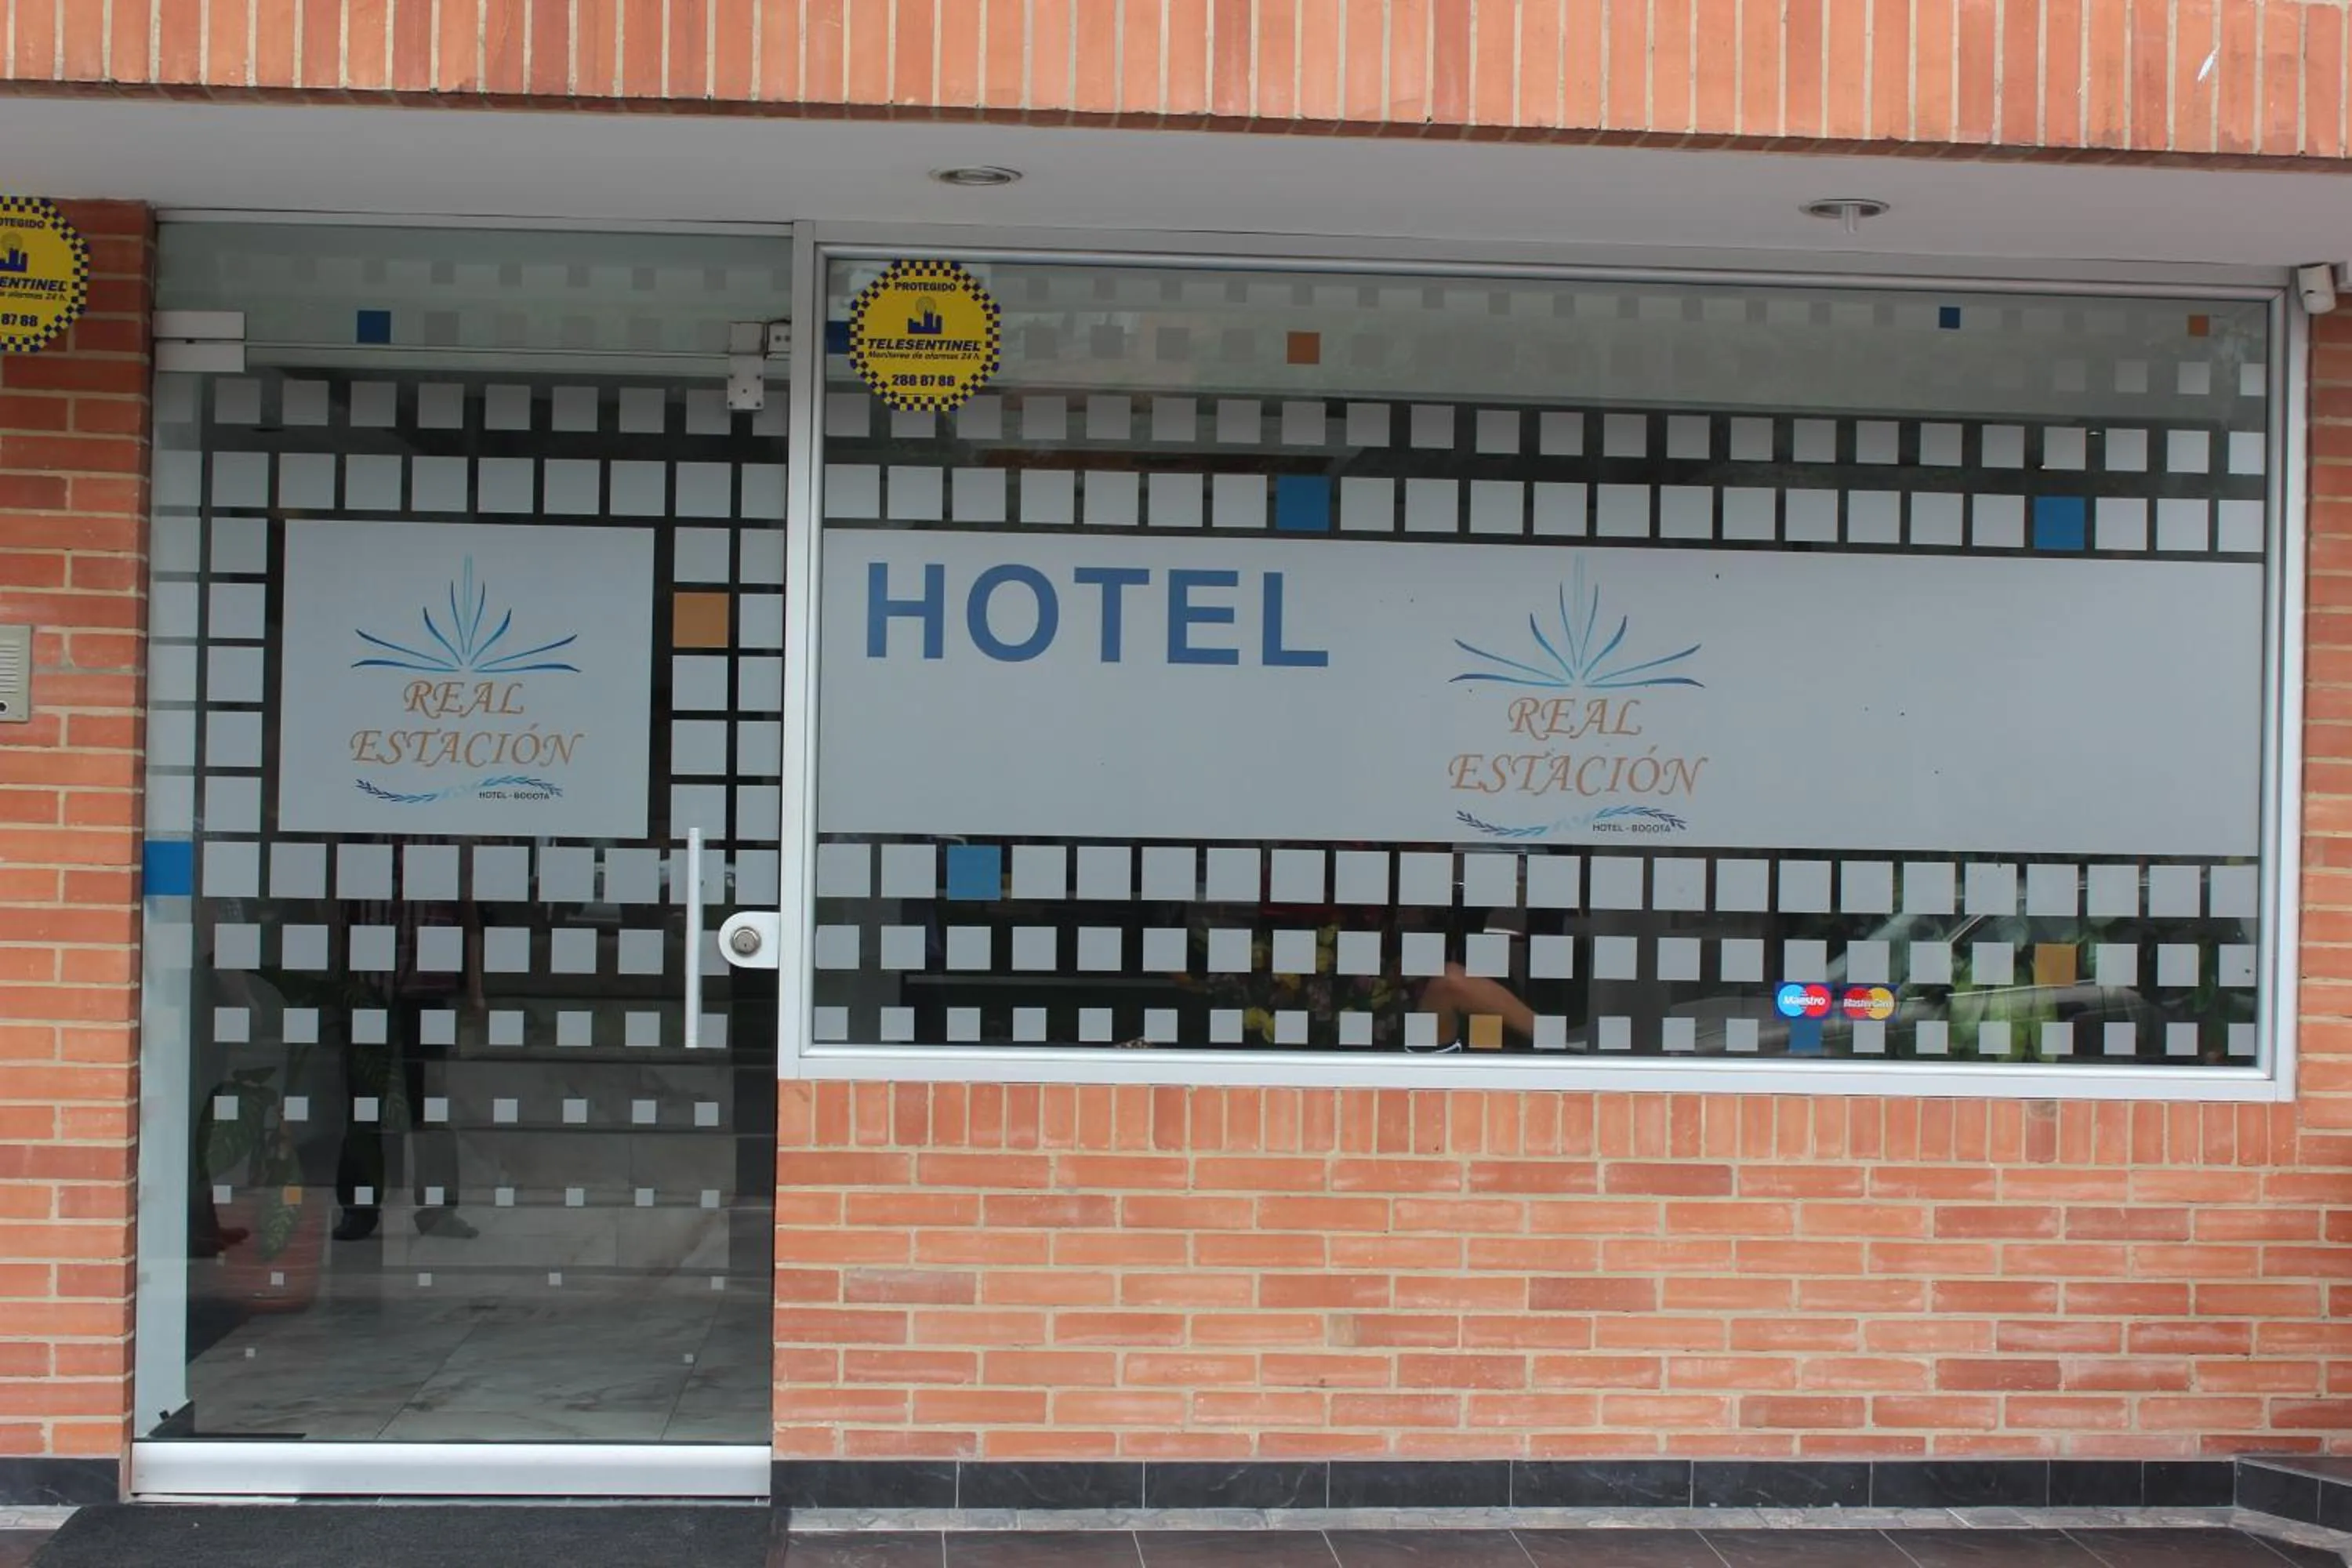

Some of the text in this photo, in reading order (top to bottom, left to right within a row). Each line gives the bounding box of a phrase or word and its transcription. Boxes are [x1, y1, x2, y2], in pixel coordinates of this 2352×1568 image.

[894, 281, 957, 292] PROTEGIDO
[867, 339, 981, 351] TELESENTINEL
[867, 562, 1329, 667] HOTEL
[403, 680, 524, 720] REAL
[1508, 697, 1642, 741] REAL
[350, 723, 585, 768] ESTACIÓN
[1448, 746, 1709, 797] ESTACIÓN
[1592, 823, 1624, 832] HOTEL
[1783, 996, 1826, 1007] Maestro
